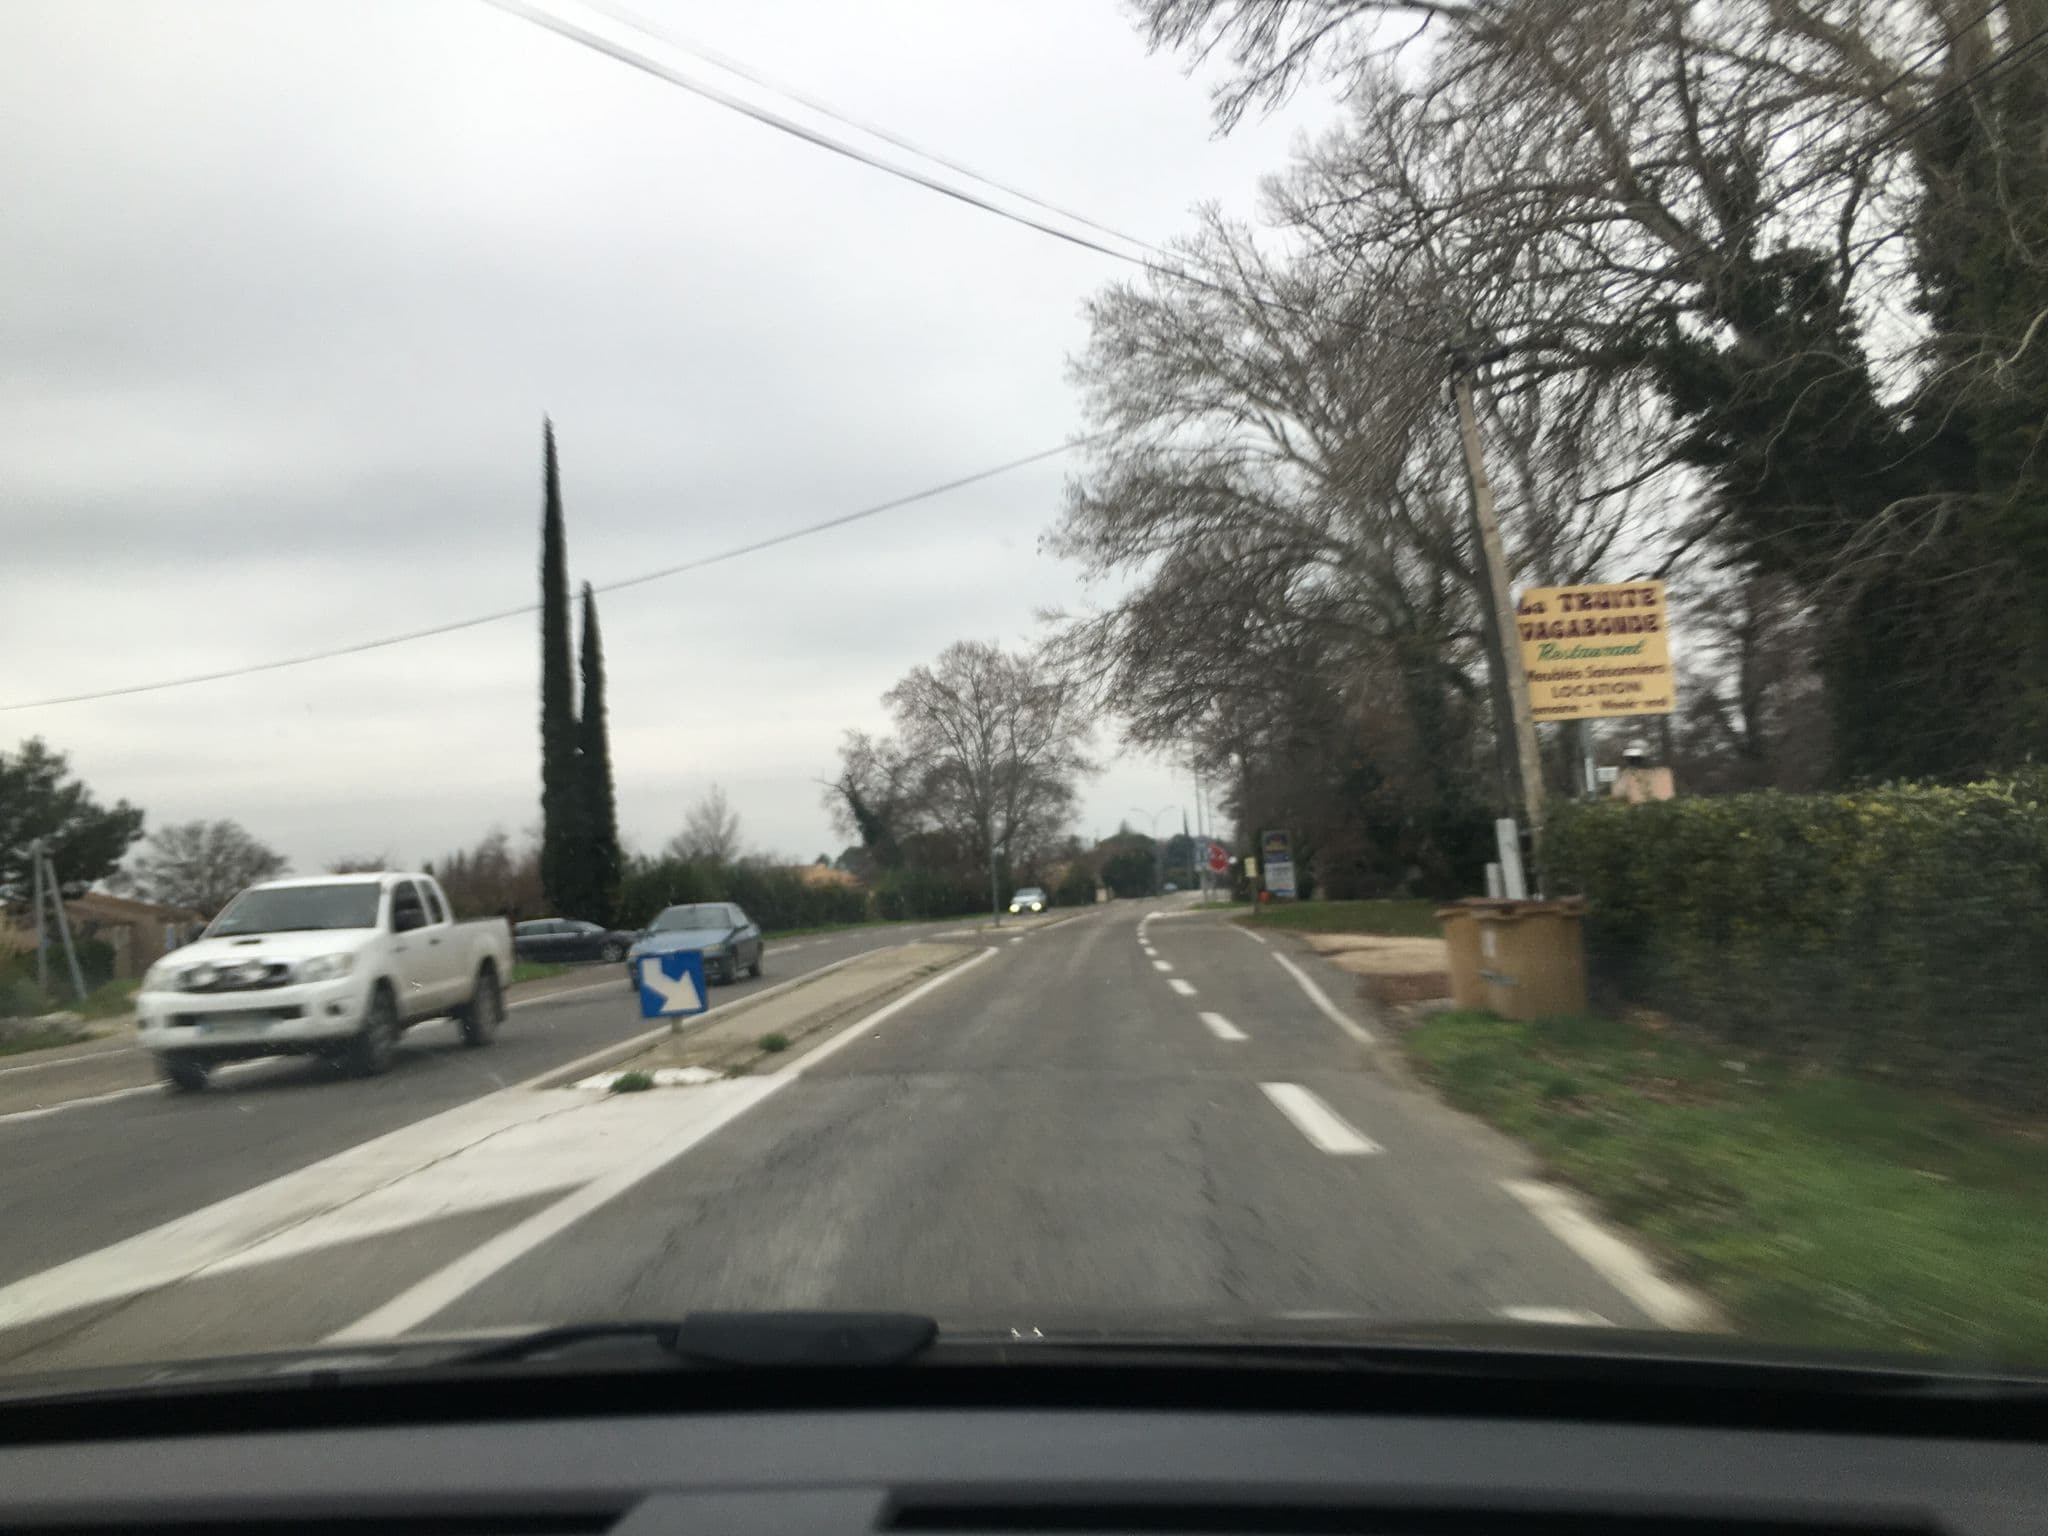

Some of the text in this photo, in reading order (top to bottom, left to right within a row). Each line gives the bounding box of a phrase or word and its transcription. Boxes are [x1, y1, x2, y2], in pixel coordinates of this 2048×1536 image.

[1558, 588, 1656, 612] TRUITE
[1518, 614, 1658, 641] VAGABONDE
[1537, 640, 1645, 661] Restaurant
[1551, 681, 1640, 698] LOCATION
